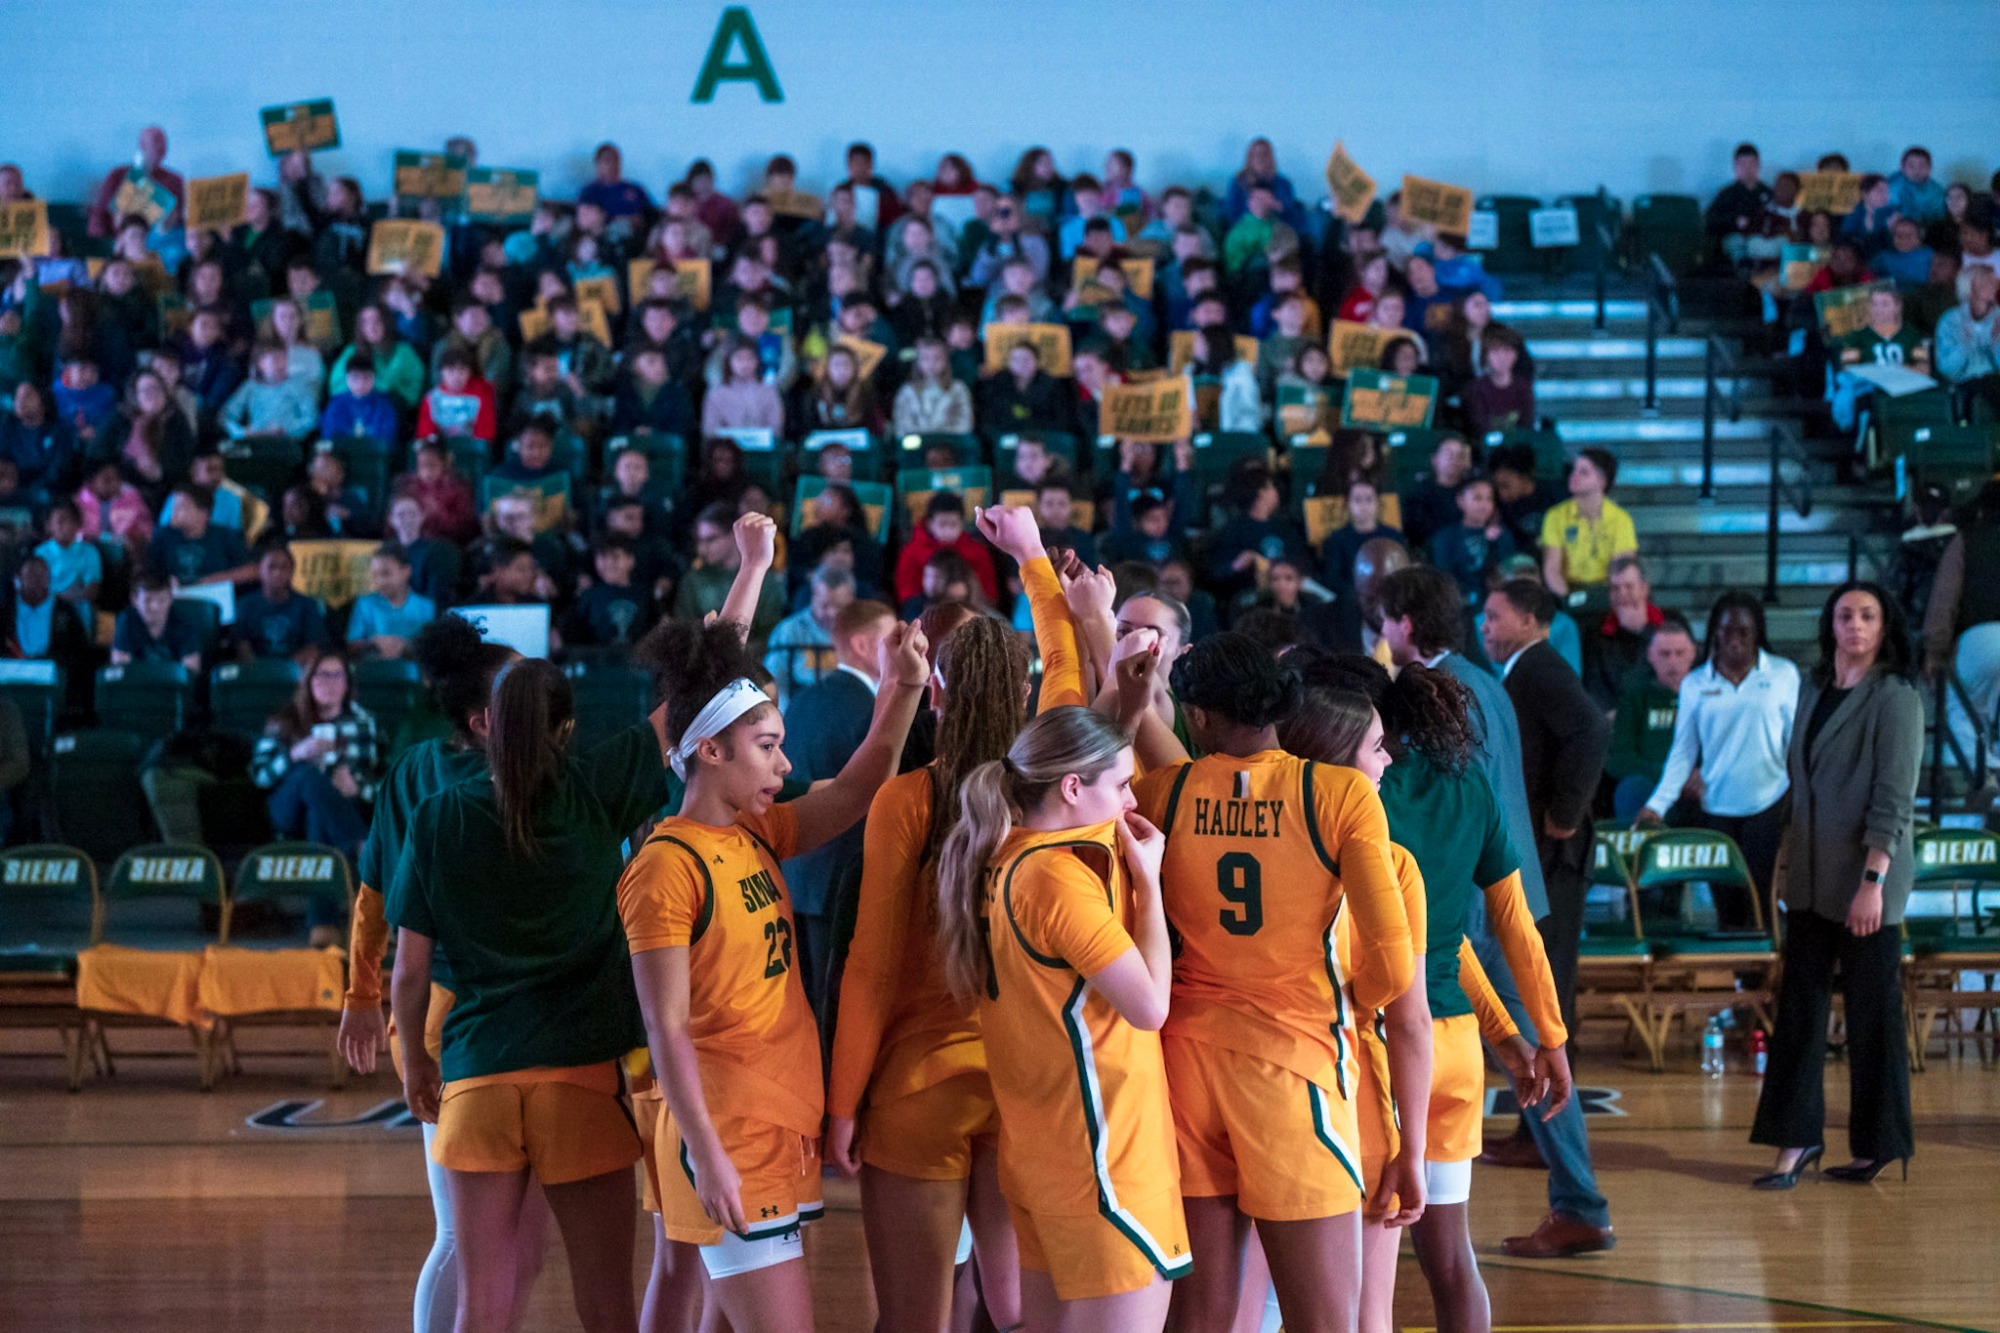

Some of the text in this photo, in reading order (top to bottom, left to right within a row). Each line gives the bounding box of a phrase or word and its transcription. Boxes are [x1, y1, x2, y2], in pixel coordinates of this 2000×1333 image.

[690, 6, 785, 104] A
[1194, 798, 1284, 837] HADLEY
[1656, 844, 1729, 867] SIENA
[1923, 840, 1997, 864] SIENA
[1216, 851, 1264, 936] 9
